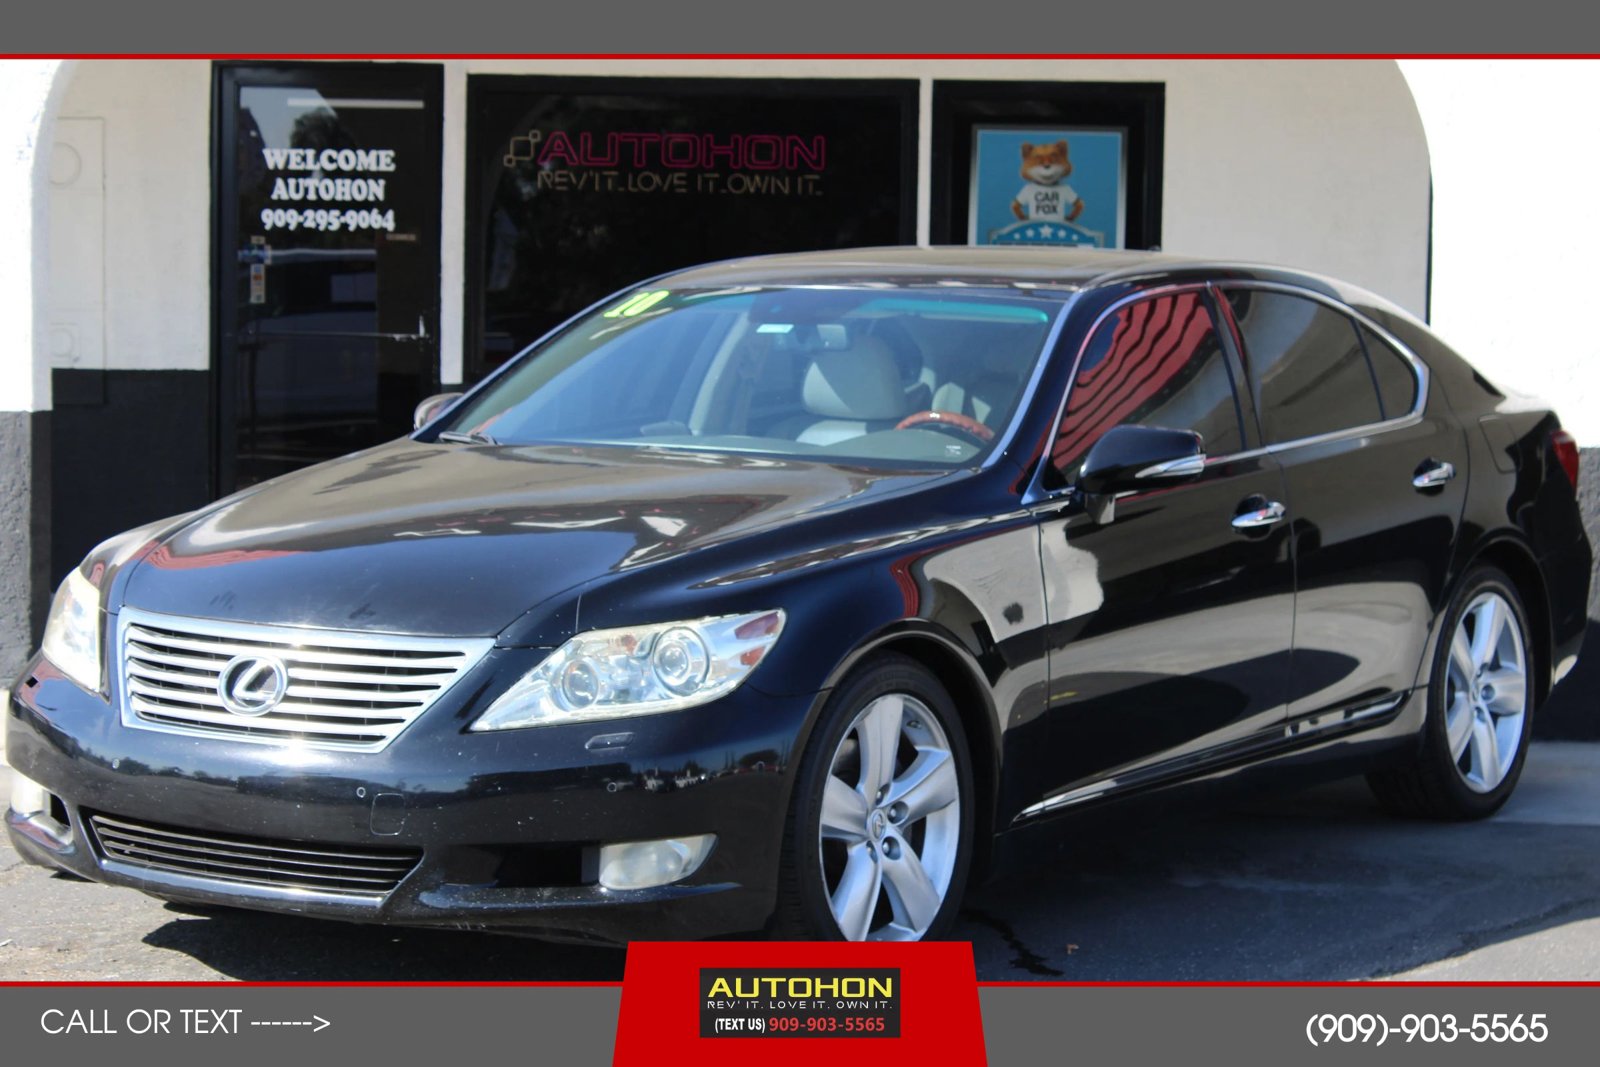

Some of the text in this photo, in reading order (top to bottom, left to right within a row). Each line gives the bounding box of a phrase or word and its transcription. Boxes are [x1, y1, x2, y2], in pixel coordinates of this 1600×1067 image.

[262, 148, 396, 172] WELCOME
[537, 131, 826, 170] AUTOHON
[271, 177, 386, 201] AUTOHON
[727, 173, 791, 195] OWN
[1034, 191, 1060, 202] CAR
[261, 208, 396, 232] 909-295-9064
[1035, 203, 1058, 215] FOX
[603, 290, 670, 317] 10
